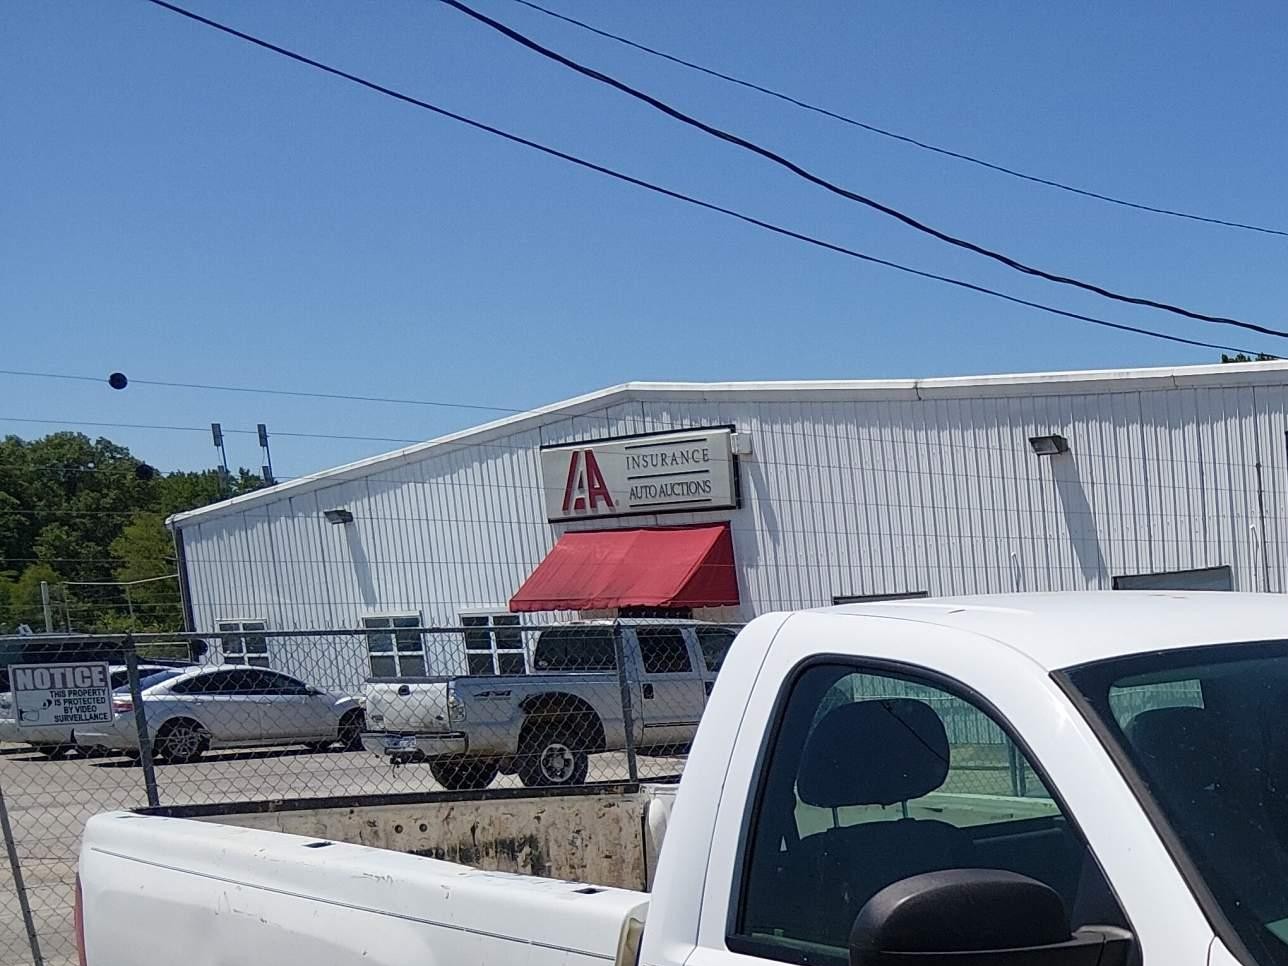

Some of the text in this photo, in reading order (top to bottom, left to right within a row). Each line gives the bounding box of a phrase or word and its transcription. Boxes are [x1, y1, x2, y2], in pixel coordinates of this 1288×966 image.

[626, 448, 710, 470] INSURANCE
[629, 479, 712, 501] AUTO AUCTIONS
[15, 666, 106, 690] NOTICE
[50, 689, 106, 698] THIS PROPERTY
[63, 697, 105, 706] PROTECTED
[63, 705, 97, 714] BY VIDEO
[54, 713, 108, 722] SURVEILLANCE
